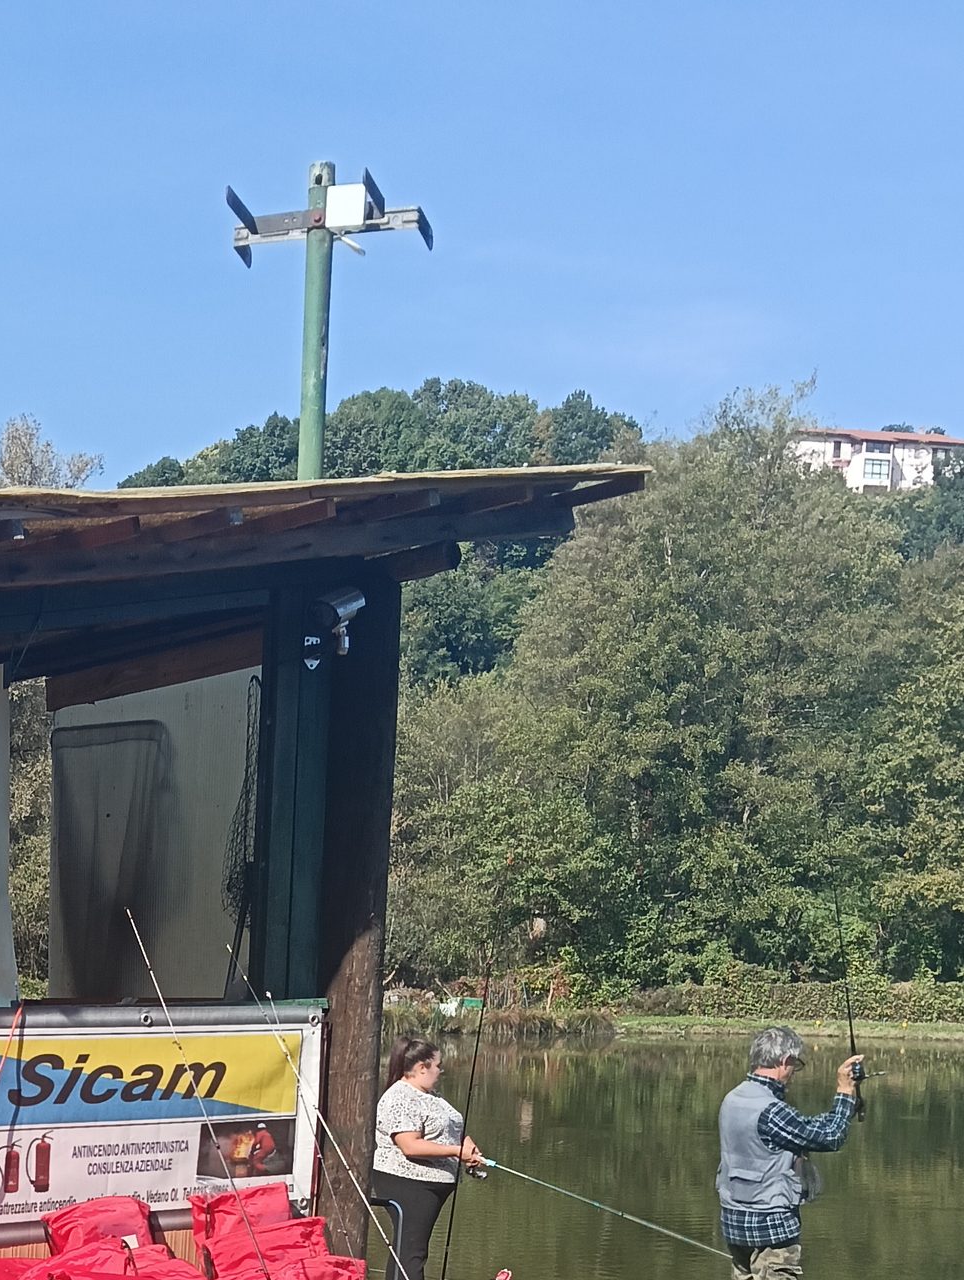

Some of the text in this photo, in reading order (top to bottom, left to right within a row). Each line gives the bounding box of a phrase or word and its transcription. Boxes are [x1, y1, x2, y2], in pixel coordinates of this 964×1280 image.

[8, 1053, 227, 1107] Sicam
[72, 1139, 189, 1159] ANTINCENDIO ANTINFORTUNISTICA
[87, 1158, 172, 1175] CONSULENZA AZIENDALE
[146, 1190, 169, 1203] Vedano
[0, 1199, 38, 1216] attrezzature
